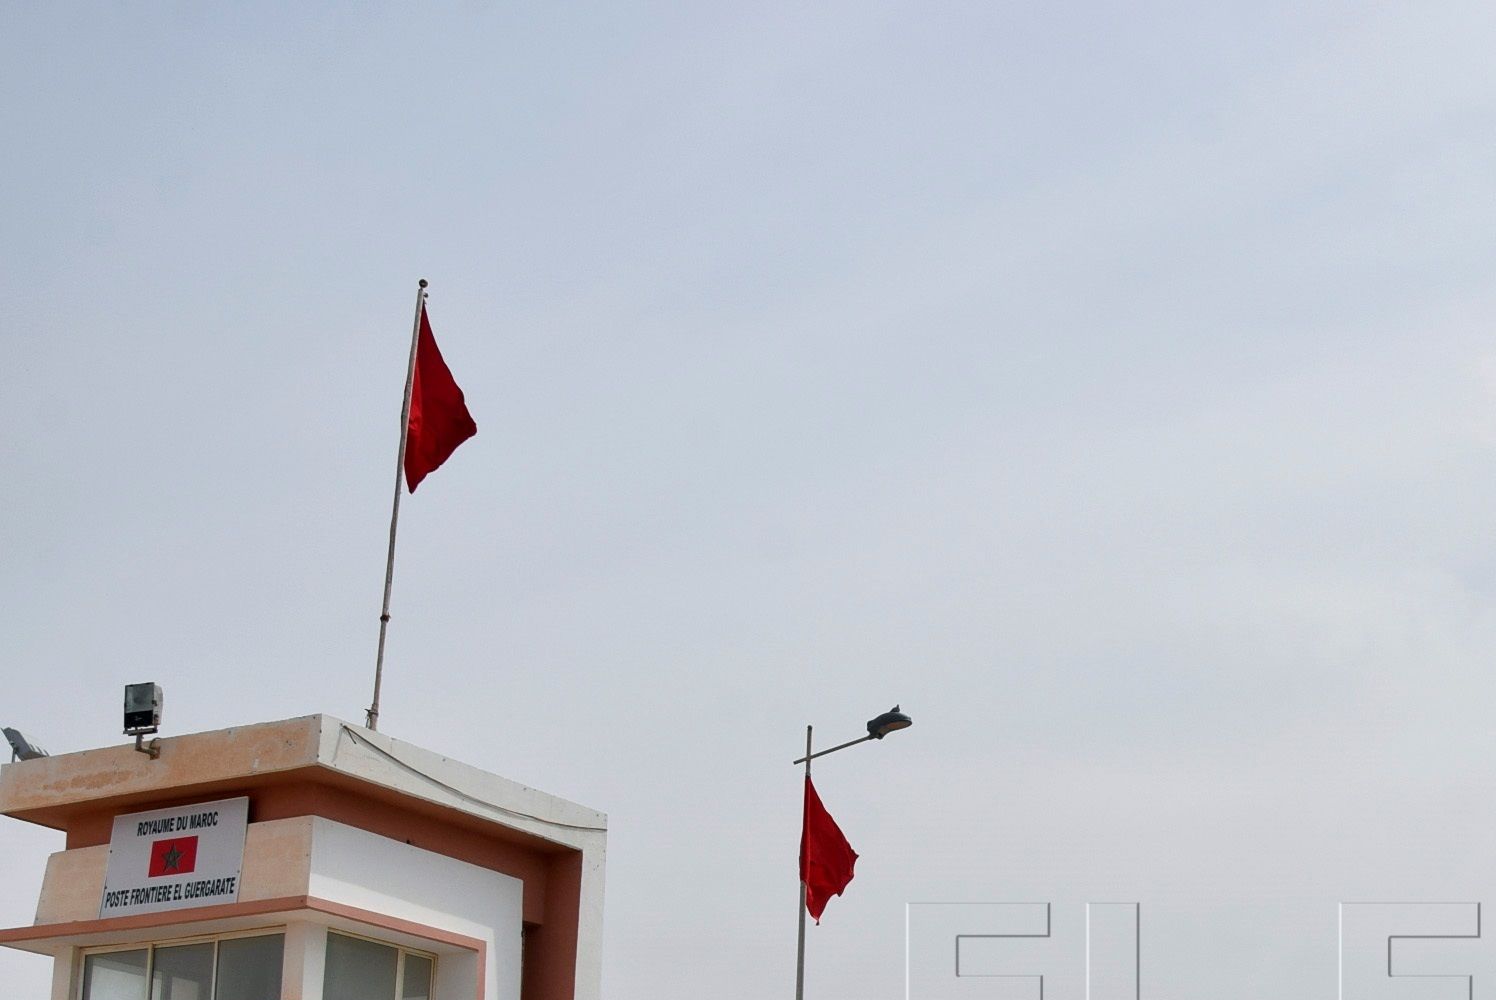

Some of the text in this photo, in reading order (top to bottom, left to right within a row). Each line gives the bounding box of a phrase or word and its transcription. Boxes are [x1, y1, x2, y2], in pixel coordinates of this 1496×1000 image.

[136, 811, 219, 837] ROYAUME DU MAROC
[104, 876, 236, 909] POSTE FRONTIERE EL GUERGARATE
